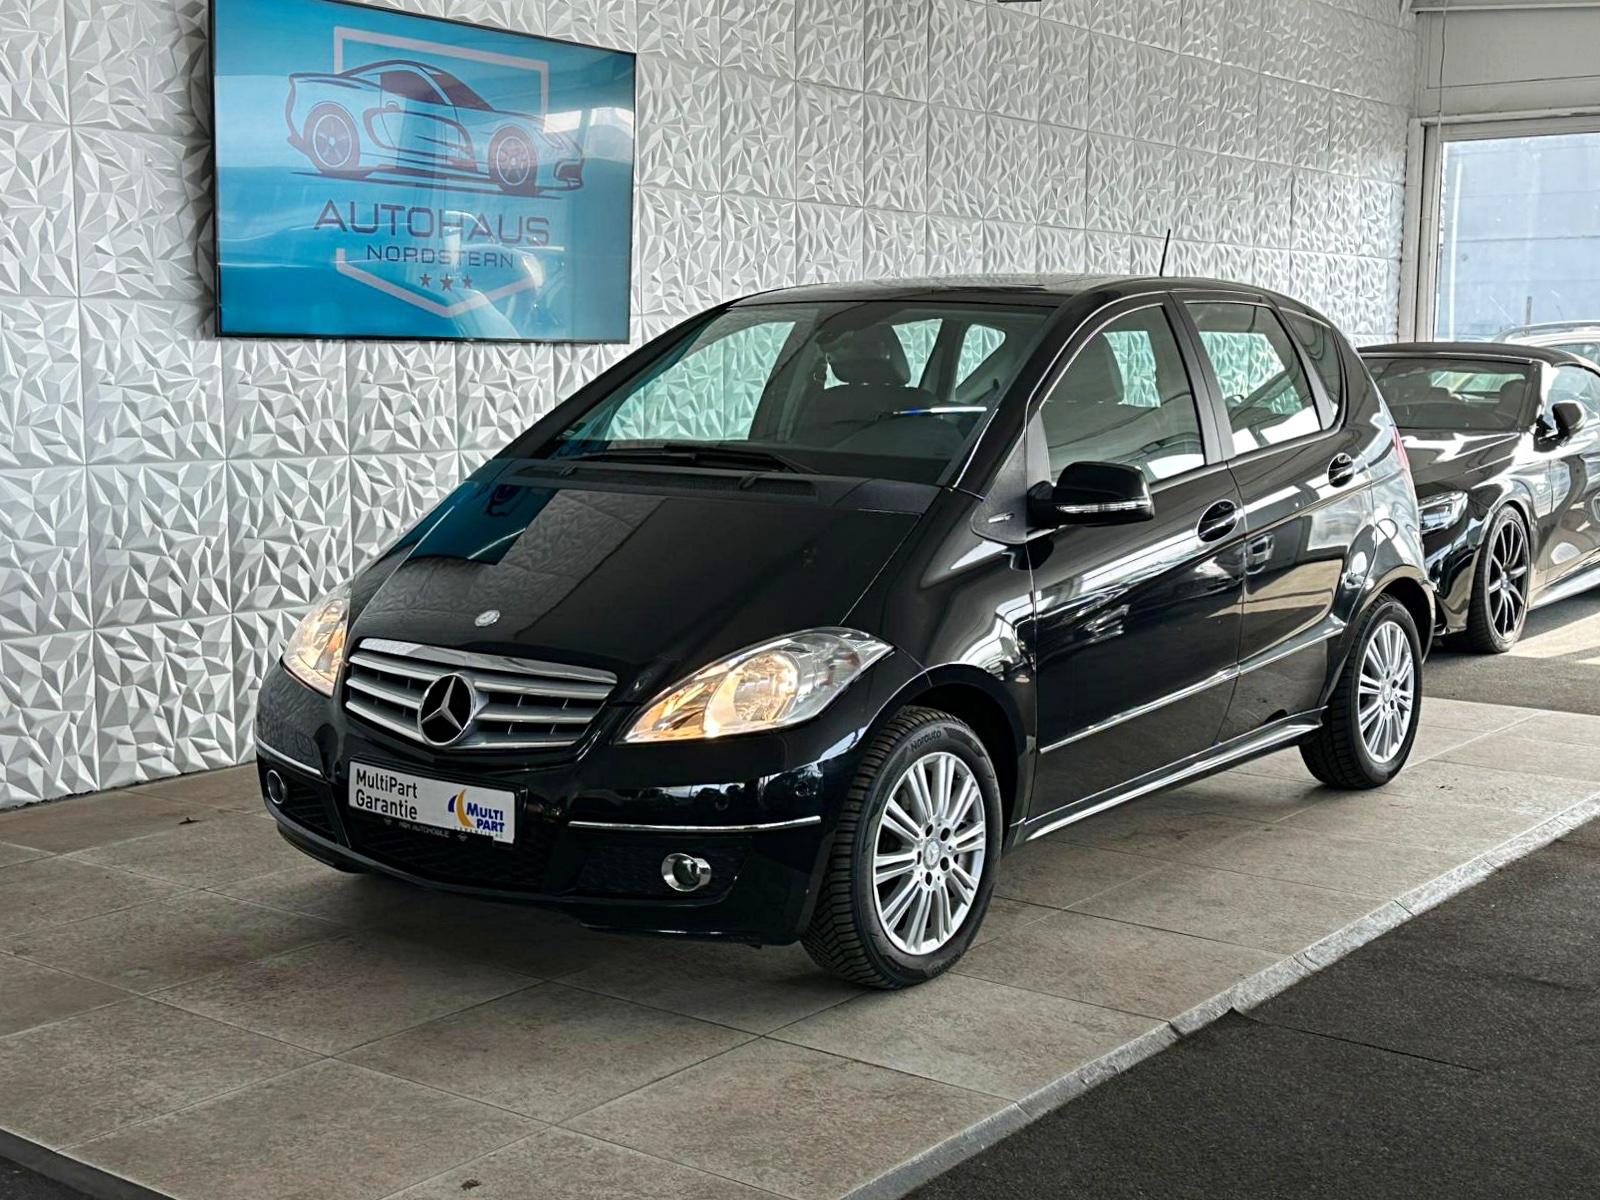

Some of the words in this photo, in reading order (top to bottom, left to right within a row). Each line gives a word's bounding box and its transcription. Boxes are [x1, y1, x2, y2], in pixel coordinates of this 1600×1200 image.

[313, 199, 550, 246] AUTOHAUS
[367, 244, 514, 269] NORDSTERN
[356, 768, 418, 799] MultiPart
[356, 789, 418, 820] Garantie
[466, 802, 504, 821] MULTI
[476, 820, 505, 833] PART
